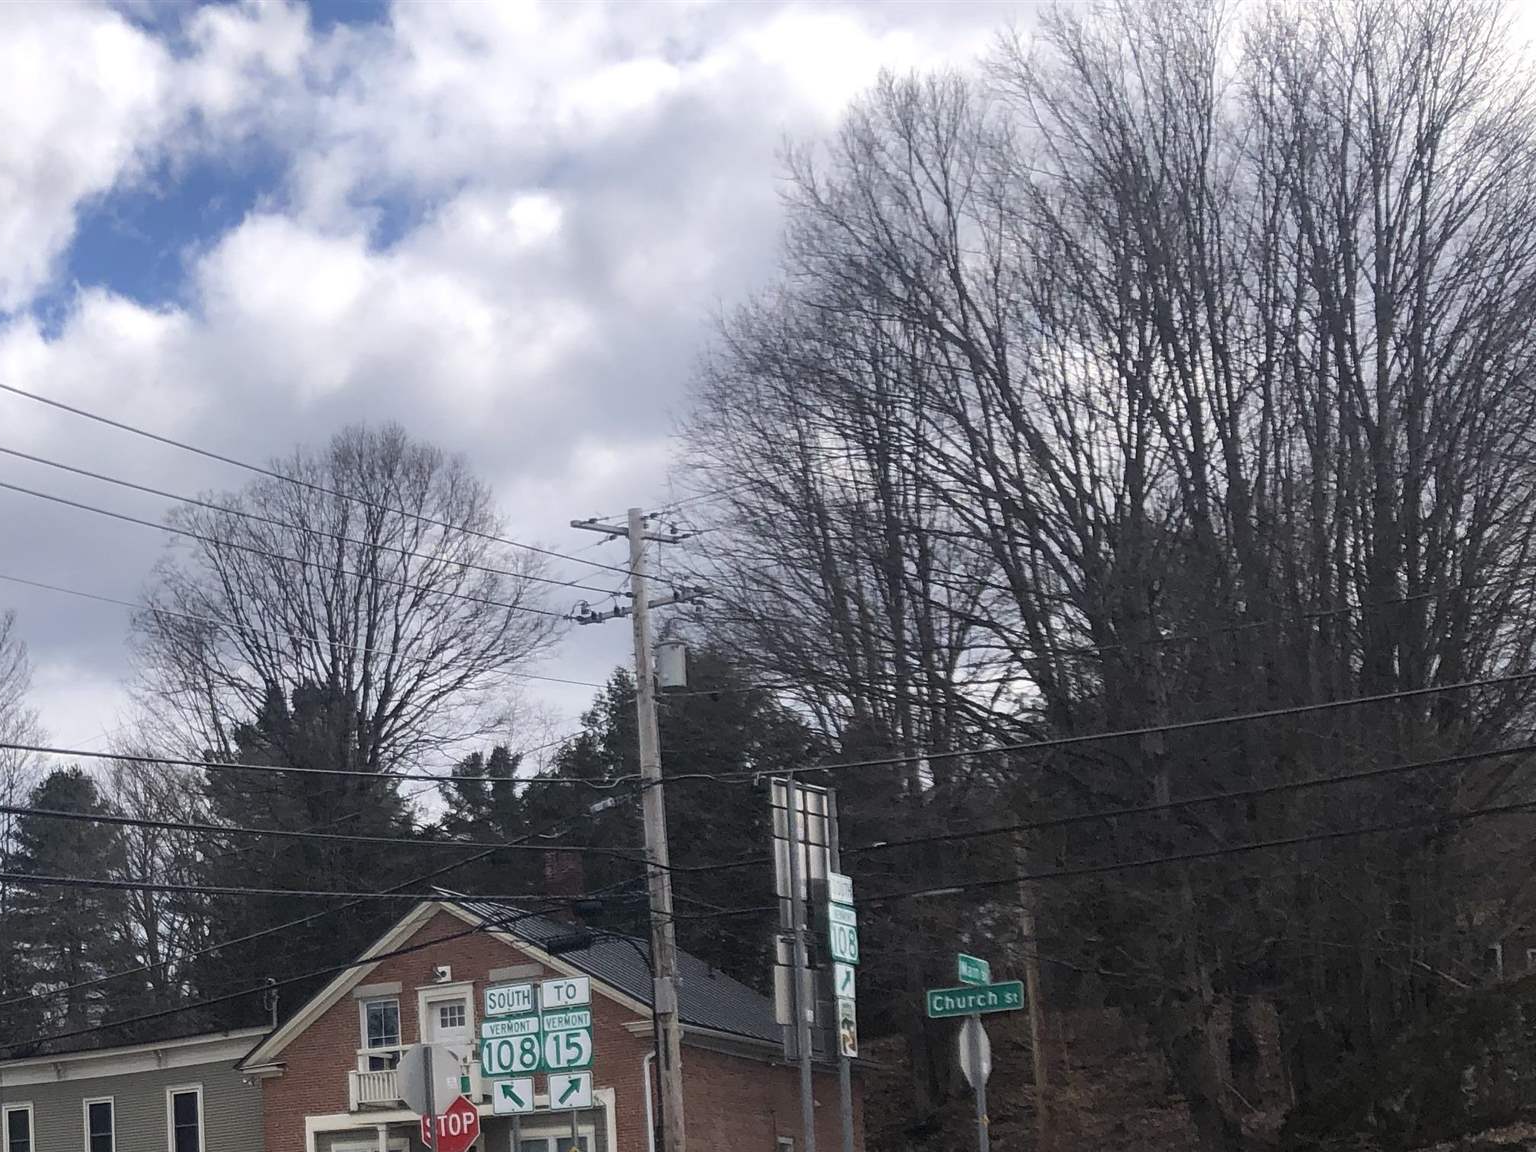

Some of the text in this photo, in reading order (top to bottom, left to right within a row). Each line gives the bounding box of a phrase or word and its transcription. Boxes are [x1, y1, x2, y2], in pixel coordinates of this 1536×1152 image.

[832, 924, 857, 959] 108
[488, 989, 531, 1010] SOUTH
[553, 983, 577, 1001] TO
[932, 991, 998, 1012] Church
[489, 1019, 532, 1035] VERMONT
[546, 1012, 589, 1029] VERMONT
[485, 1037, 537, 1072] 108
[553, 1031, 583, 1066] 15
